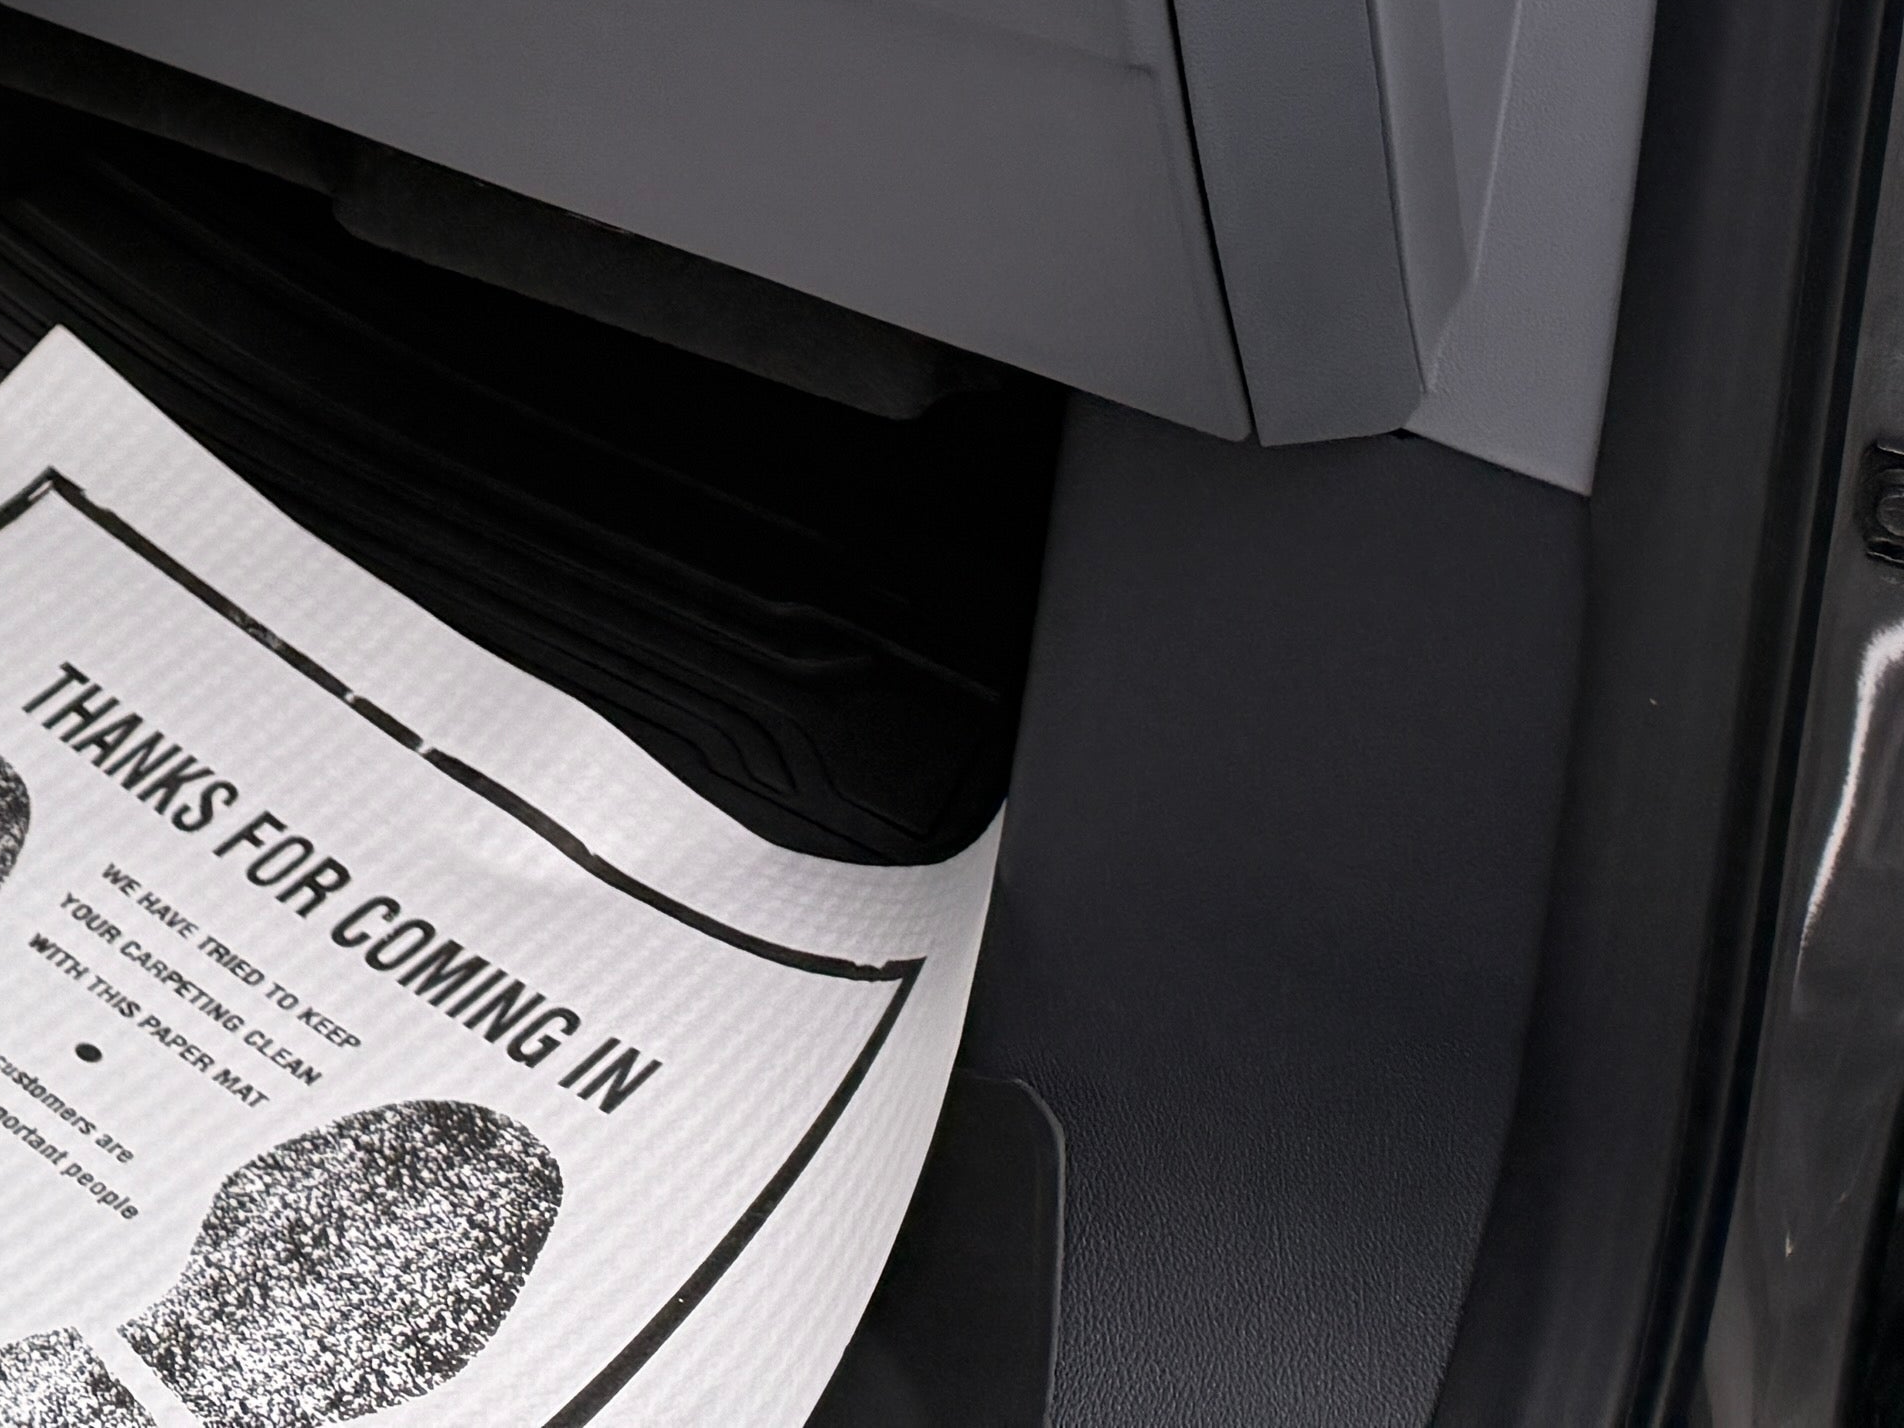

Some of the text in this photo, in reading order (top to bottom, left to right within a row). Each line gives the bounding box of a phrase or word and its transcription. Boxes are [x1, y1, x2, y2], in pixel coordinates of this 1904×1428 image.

[21, 661, 665, 1115] THANKS FOR COMING IN
[101, 862, 363, 1050] WE HAVE TRIED TO KEEP
[28, 932, 271, 1109] WITH THIS PAPER MAT
[59, 892, 323, 1087] YOUR CARPETING CLEAN
[59, 1161, 140, 1222] people
[95, 1132, 135, 1165] are
